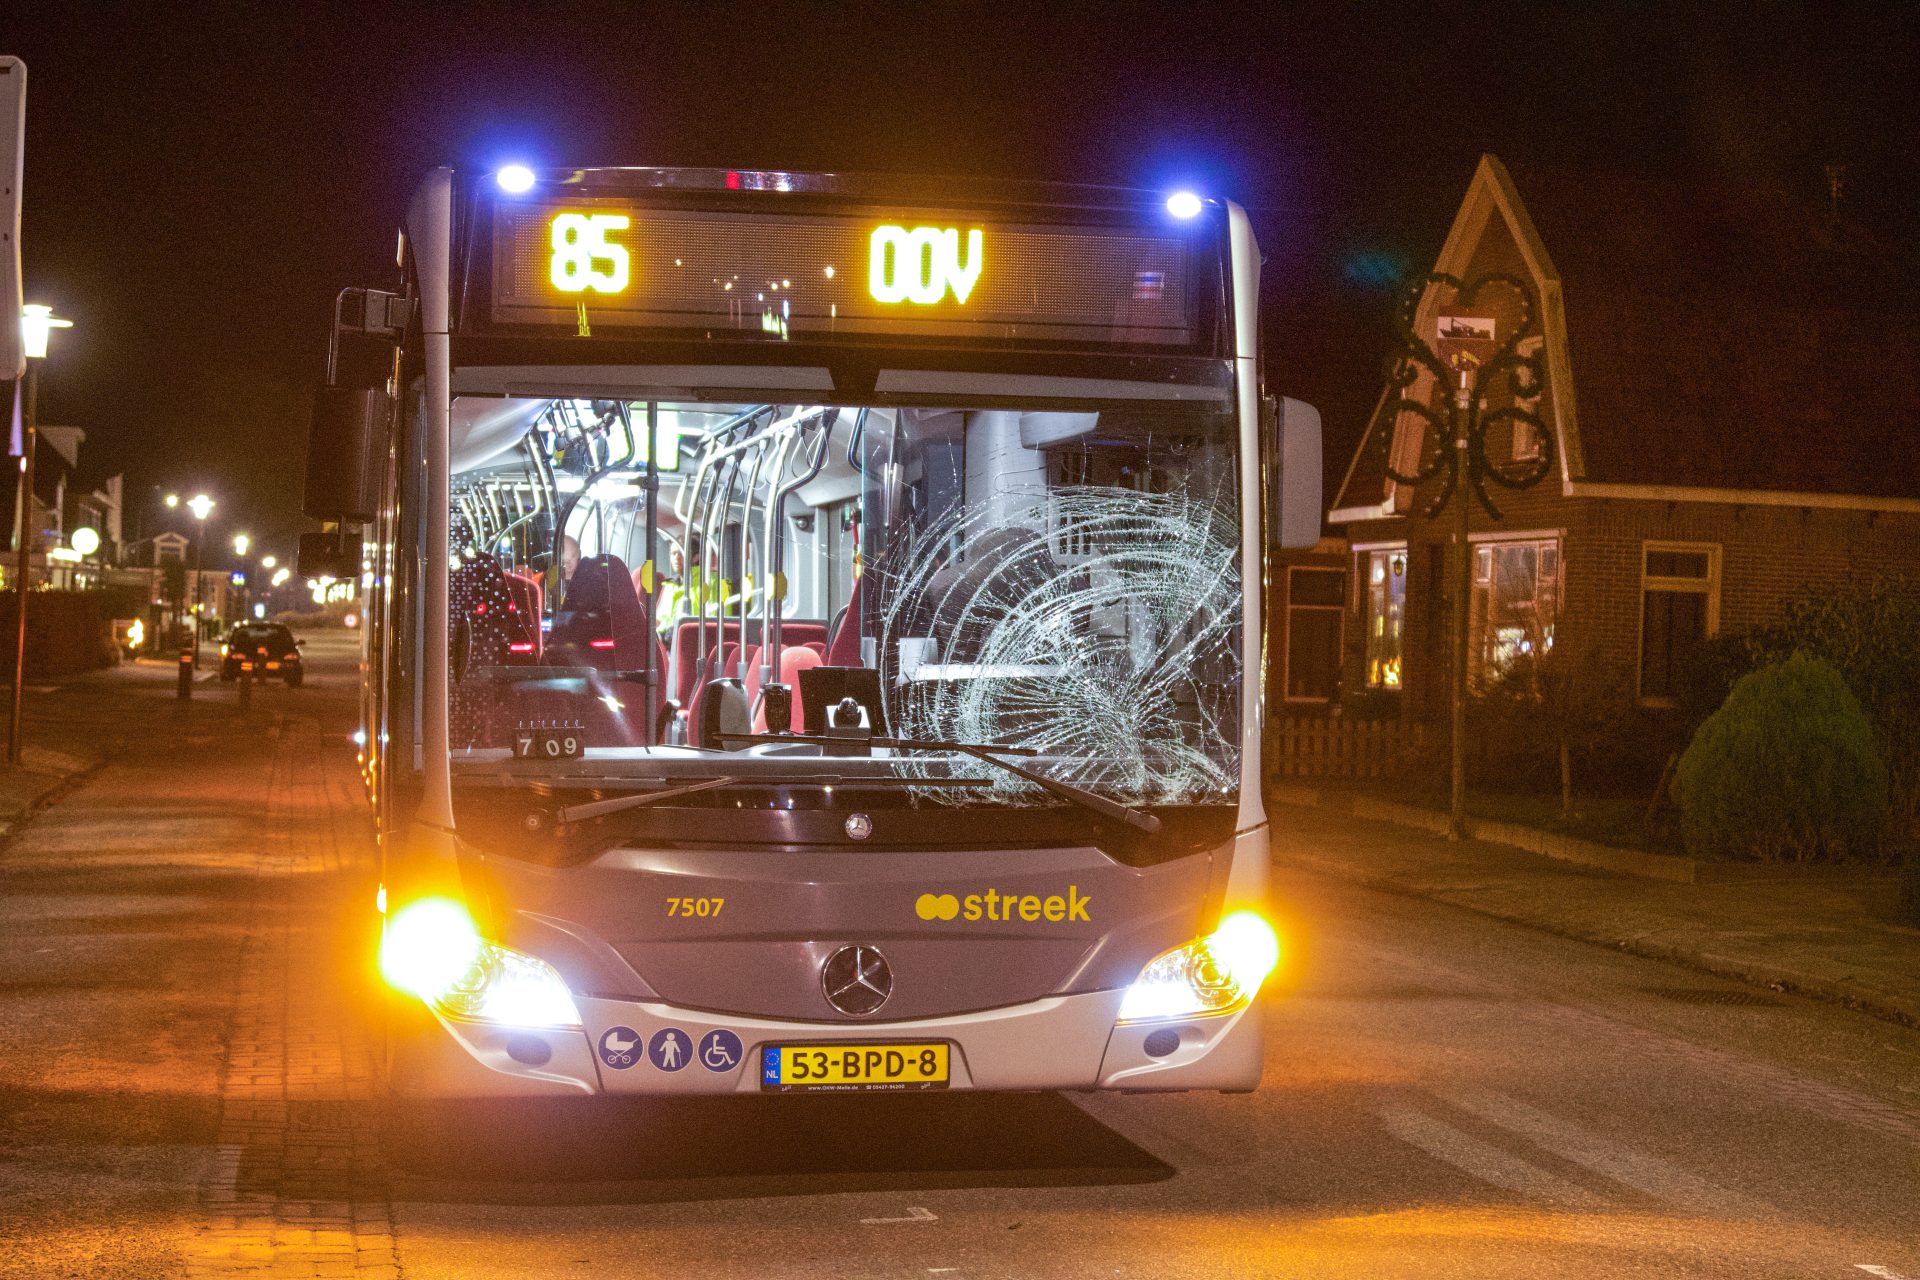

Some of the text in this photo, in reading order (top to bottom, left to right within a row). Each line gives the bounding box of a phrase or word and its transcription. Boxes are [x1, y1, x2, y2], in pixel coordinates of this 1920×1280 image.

[550, 213, 630, 293] 85
[666, 897, 725, 917] 7507
[963, 885, 1092, 922] streek
[765, 1070, 779, 1079] NL
[791, 1049, 937, 1080] 53-BPD-8
